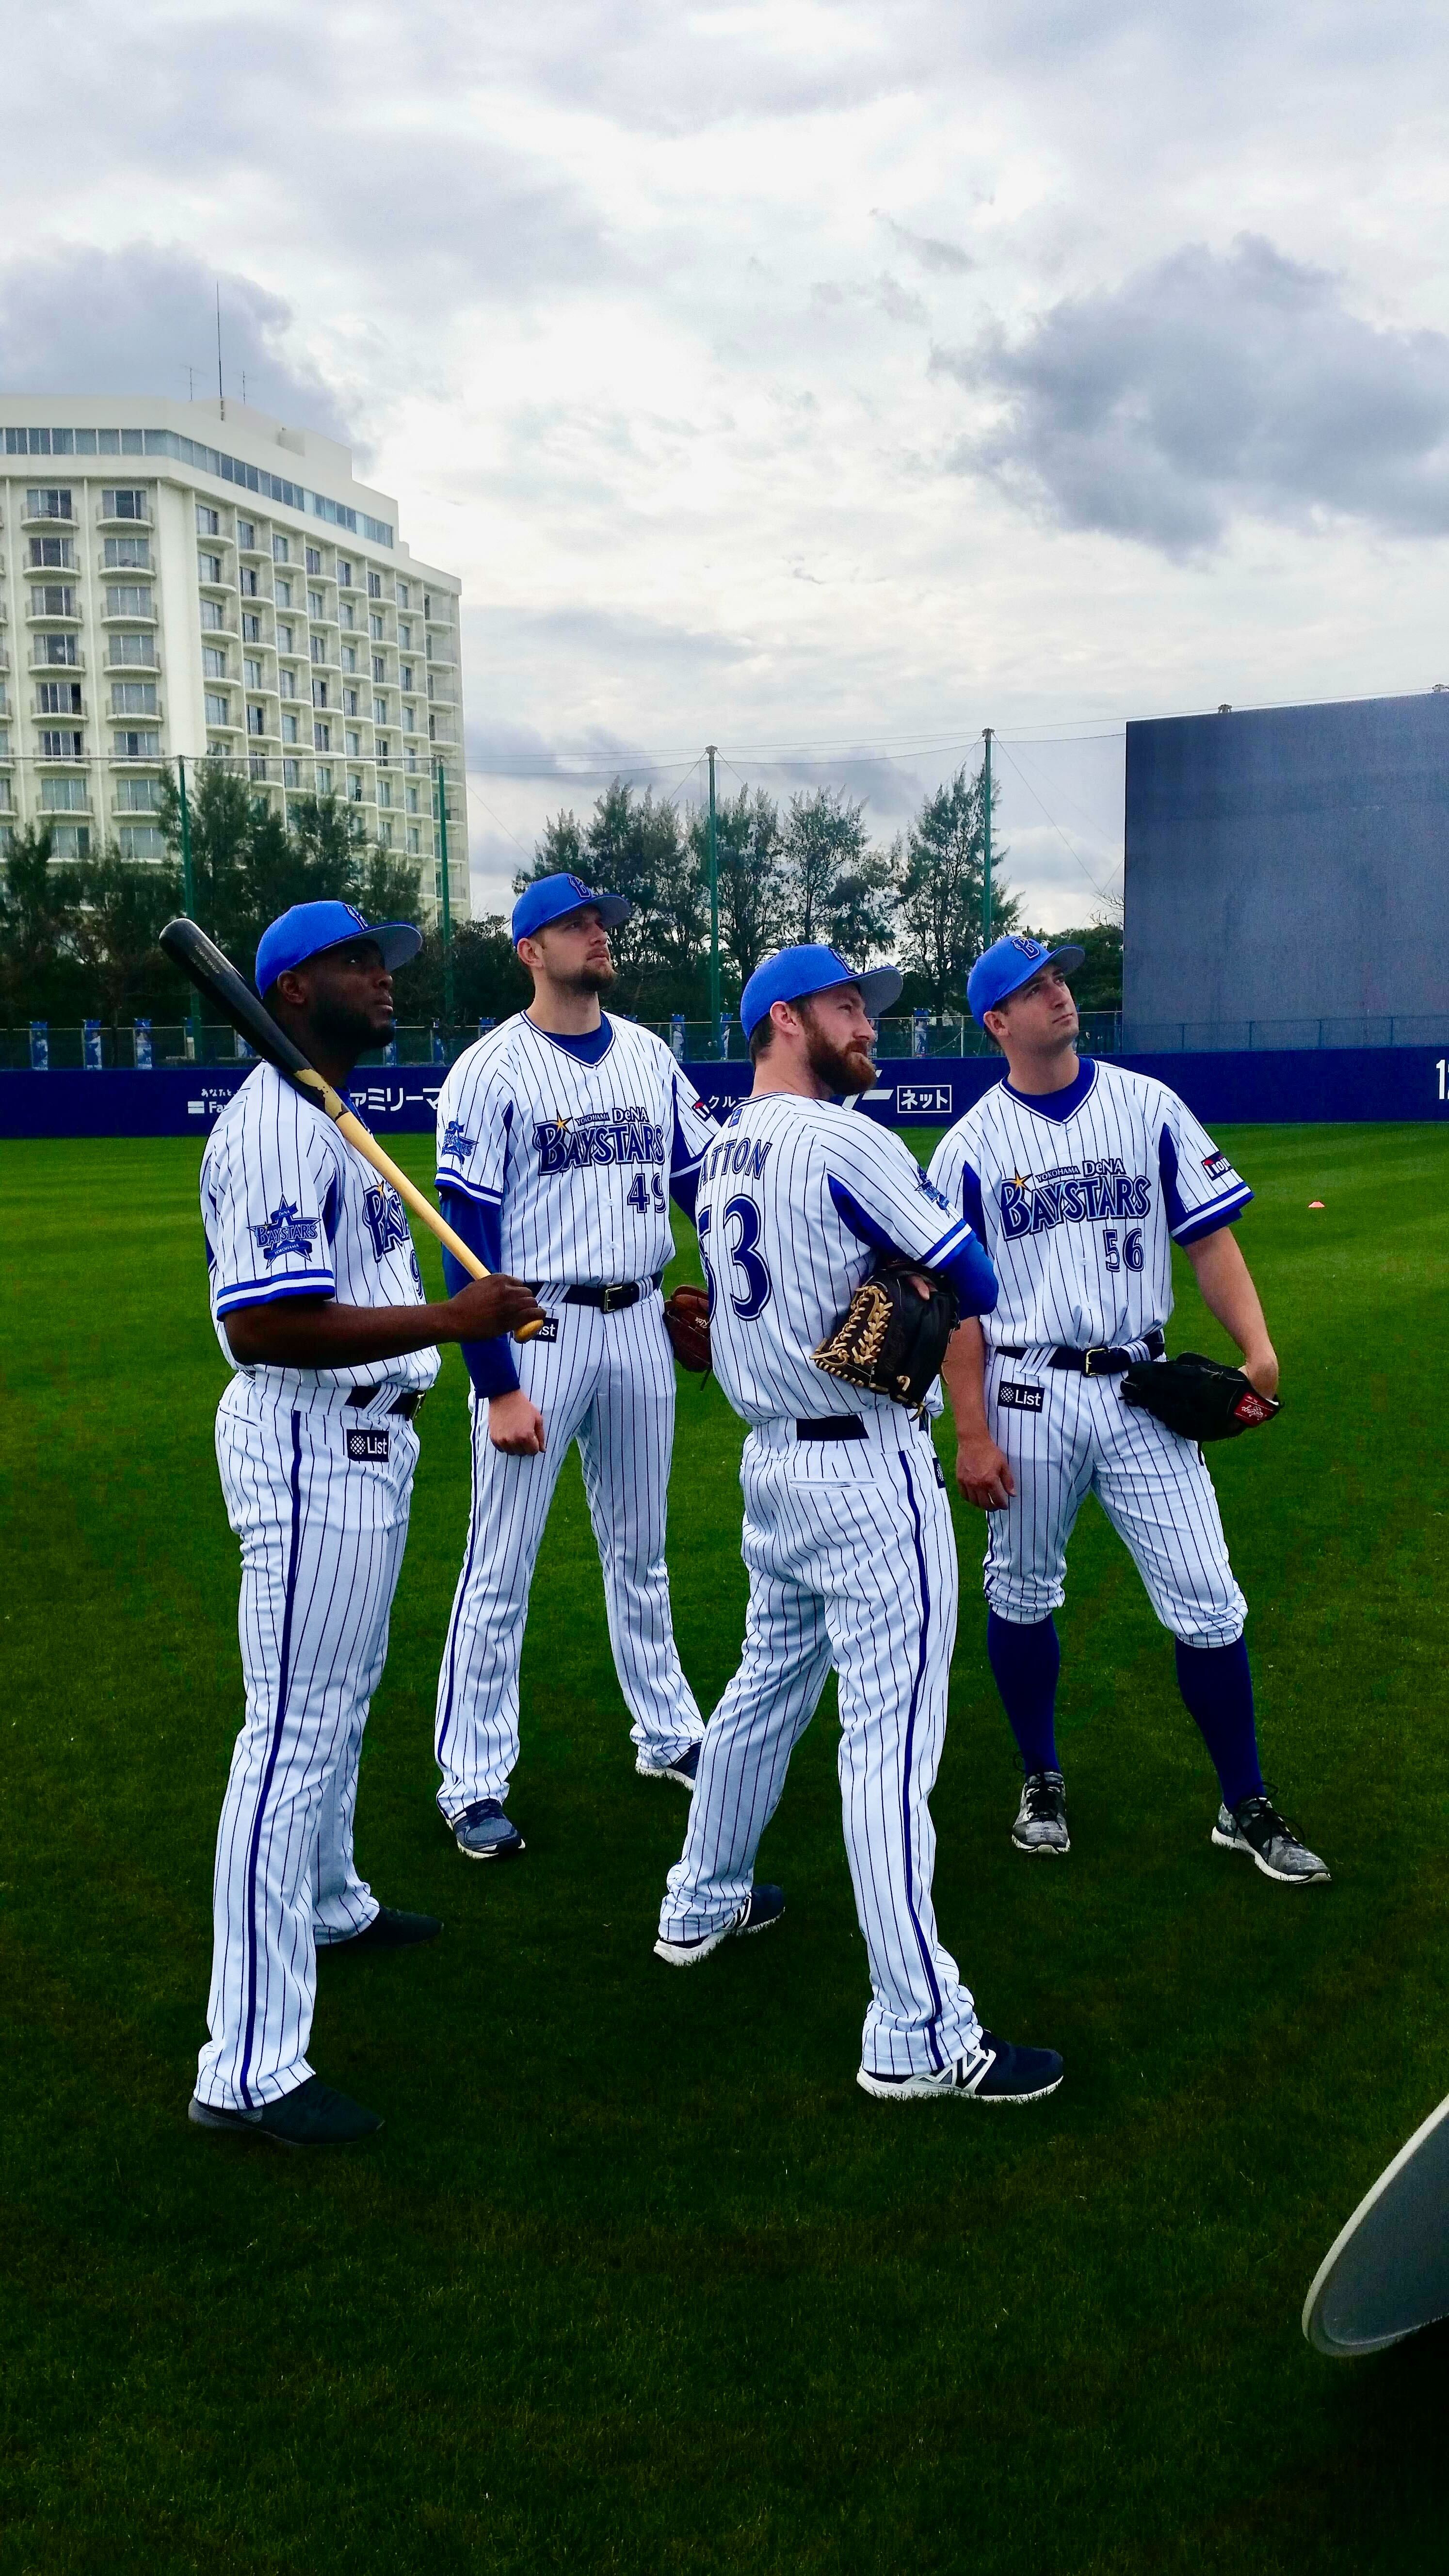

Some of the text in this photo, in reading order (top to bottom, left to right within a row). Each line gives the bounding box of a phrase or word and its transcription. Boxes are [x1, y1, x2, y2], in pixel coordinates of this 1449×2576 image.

[1012, 937, 1039, 959] B
[1436, 1059, 1449, 1100] 1
[350, 1088, 441, 1111] ァミリーマ
[901, 1089, 948, 1110] ネット
[575, 1107, 650, 1126] YOKOHAMA DeNA
[532, 1120, 665, 1176] BAYSTARS
[700, 1138, 773, 1193] ATTON
[1035, 1158, 1127, 1183] YOKOHAMA DeNA
[627, 1172, 667, 1213] 49
[1000, 1175, 1152, 1241] BAYSTARS
[255, 1224, 318, 1247] BAYSTARS
[274, 1243, 299, 1256] YOKOHAMA
[1103, 1228, 1145, 1272] 56
[1015, 1389, 1041, 1406] List
[367, 1436, 387, 1455] List
